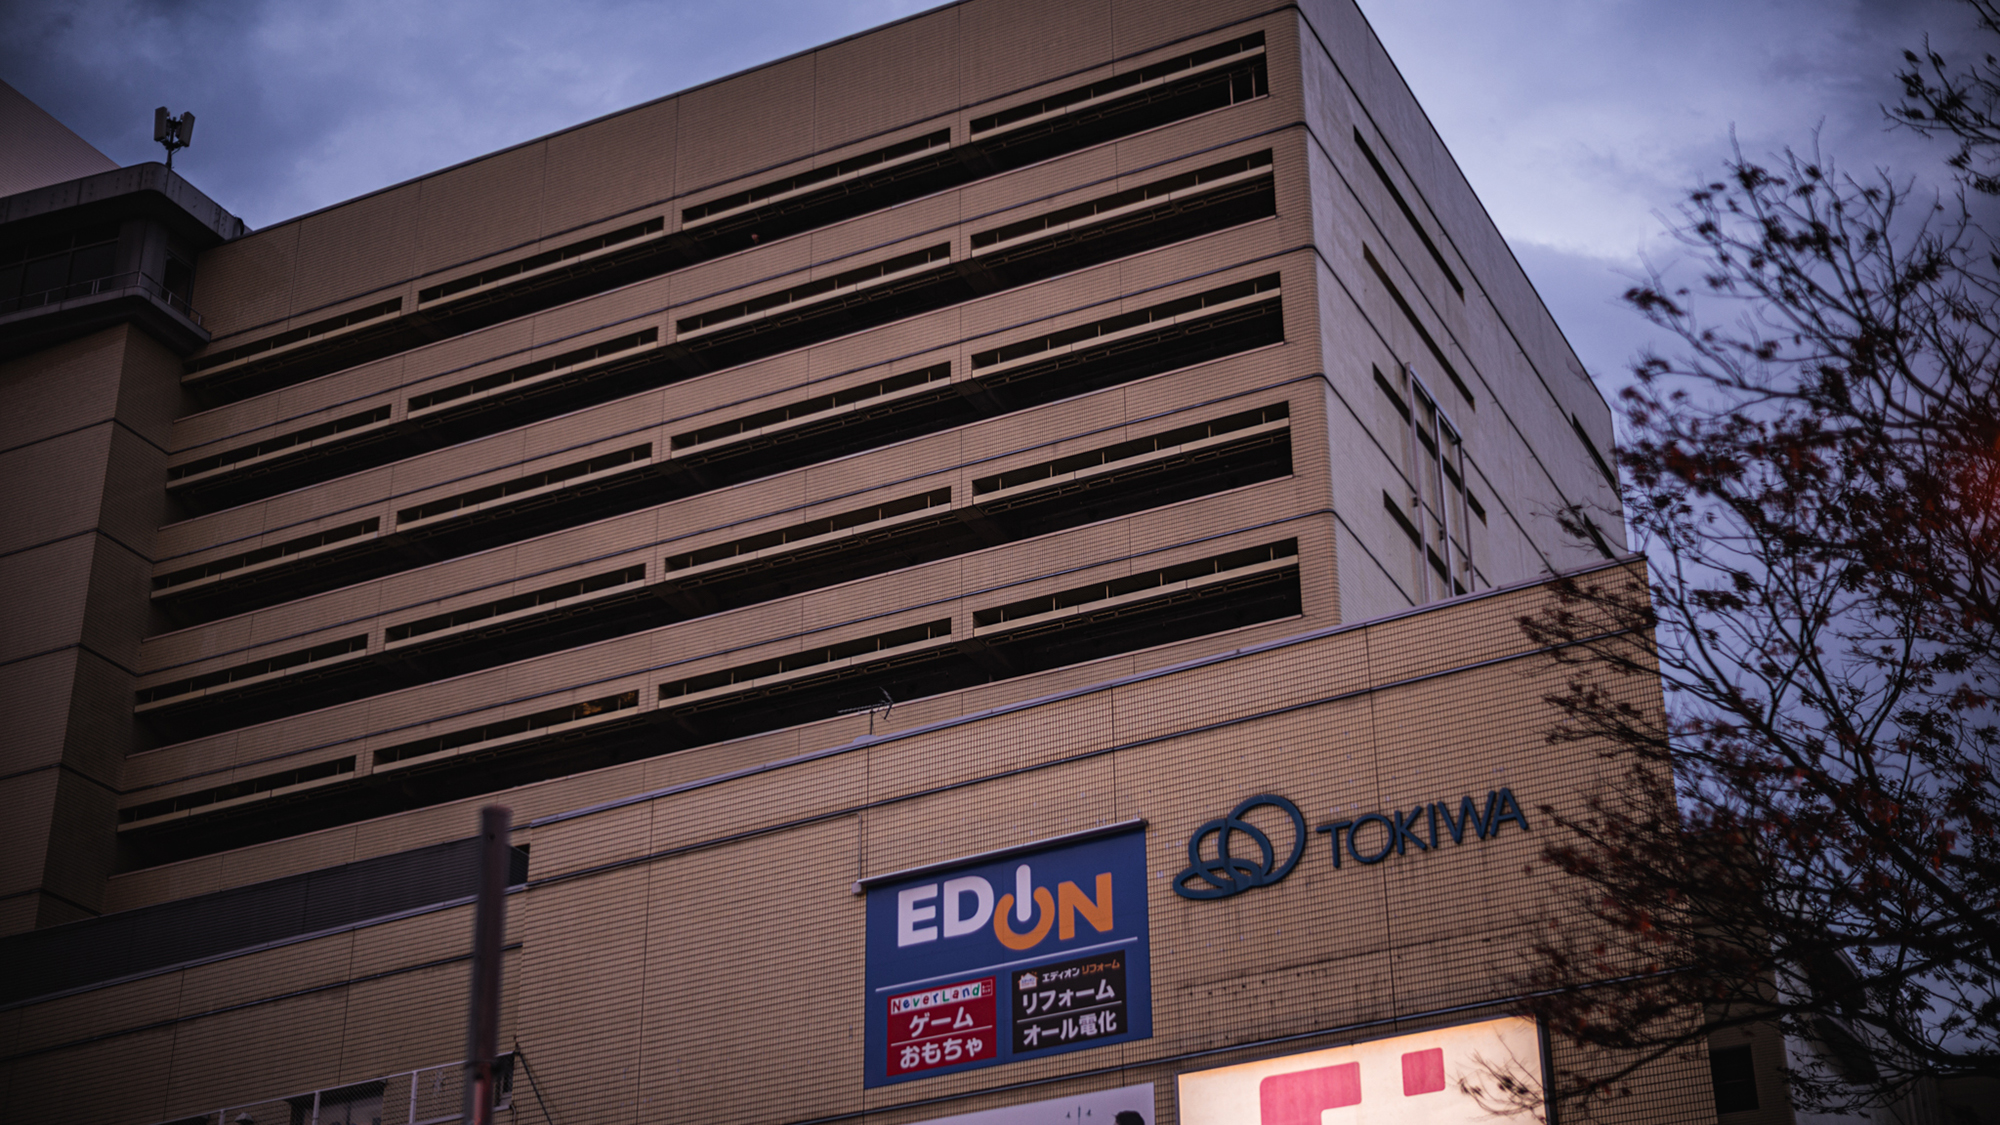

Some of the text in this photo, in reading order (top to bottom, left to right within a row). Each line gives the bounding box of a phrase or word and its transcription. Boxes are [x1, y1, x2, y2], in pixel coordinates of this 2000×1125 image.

[1316, 787, 1528, 868] TOKIWA
[897, 863, 1114, 950] EDION
[1041, 967, 1080, 983] エディオン
[1081, 959, 1120, 975] リフォーム
[892, 983, 981, 1013] NeverLand
[1022, 979, 1116, 1015] リフォーム
[909, 1006, 974, 1038] ゲーム
[1023, 1009, 1118, 1046] オール電化
[900, 1037, 983, 1069] おもちゃ
